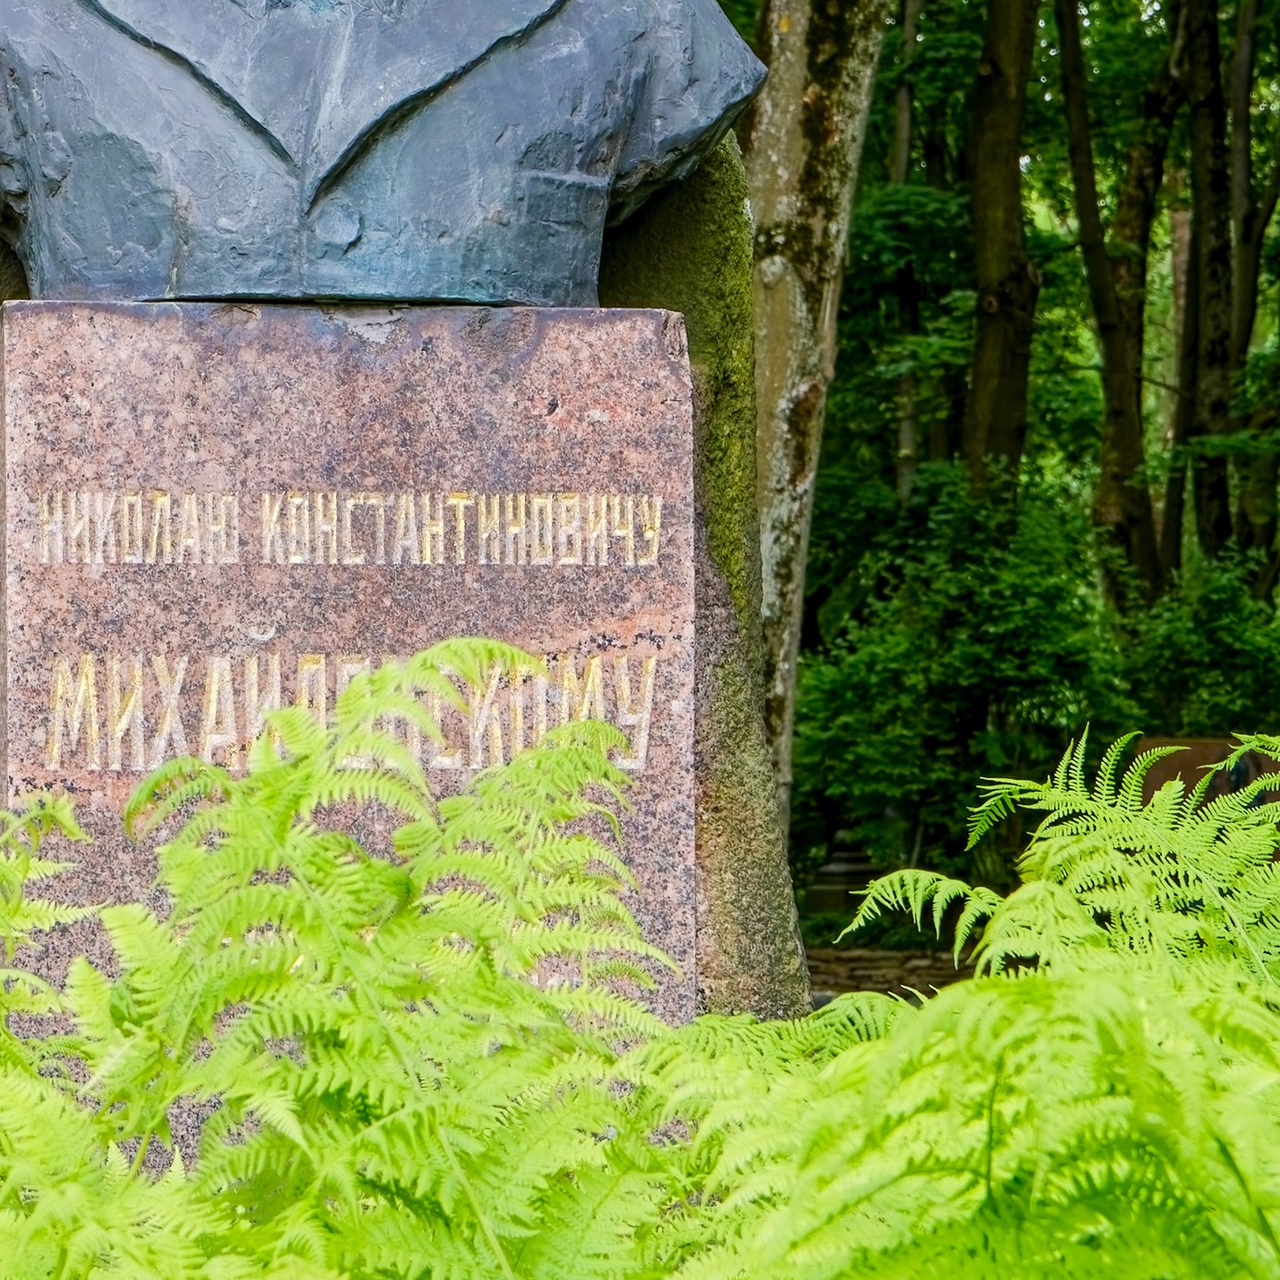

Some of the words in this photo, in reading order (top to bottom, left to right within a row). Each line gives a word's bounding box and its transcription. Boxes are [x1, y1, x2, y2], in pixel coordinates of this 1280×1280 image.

[37, 490, 239, 564] НИКОЛАЮ
[261, 490, 663, 566] КОНСТАНТИНОВИЧУ
[45, 626, 658, 770] МИХАЙЛСКОМУ
